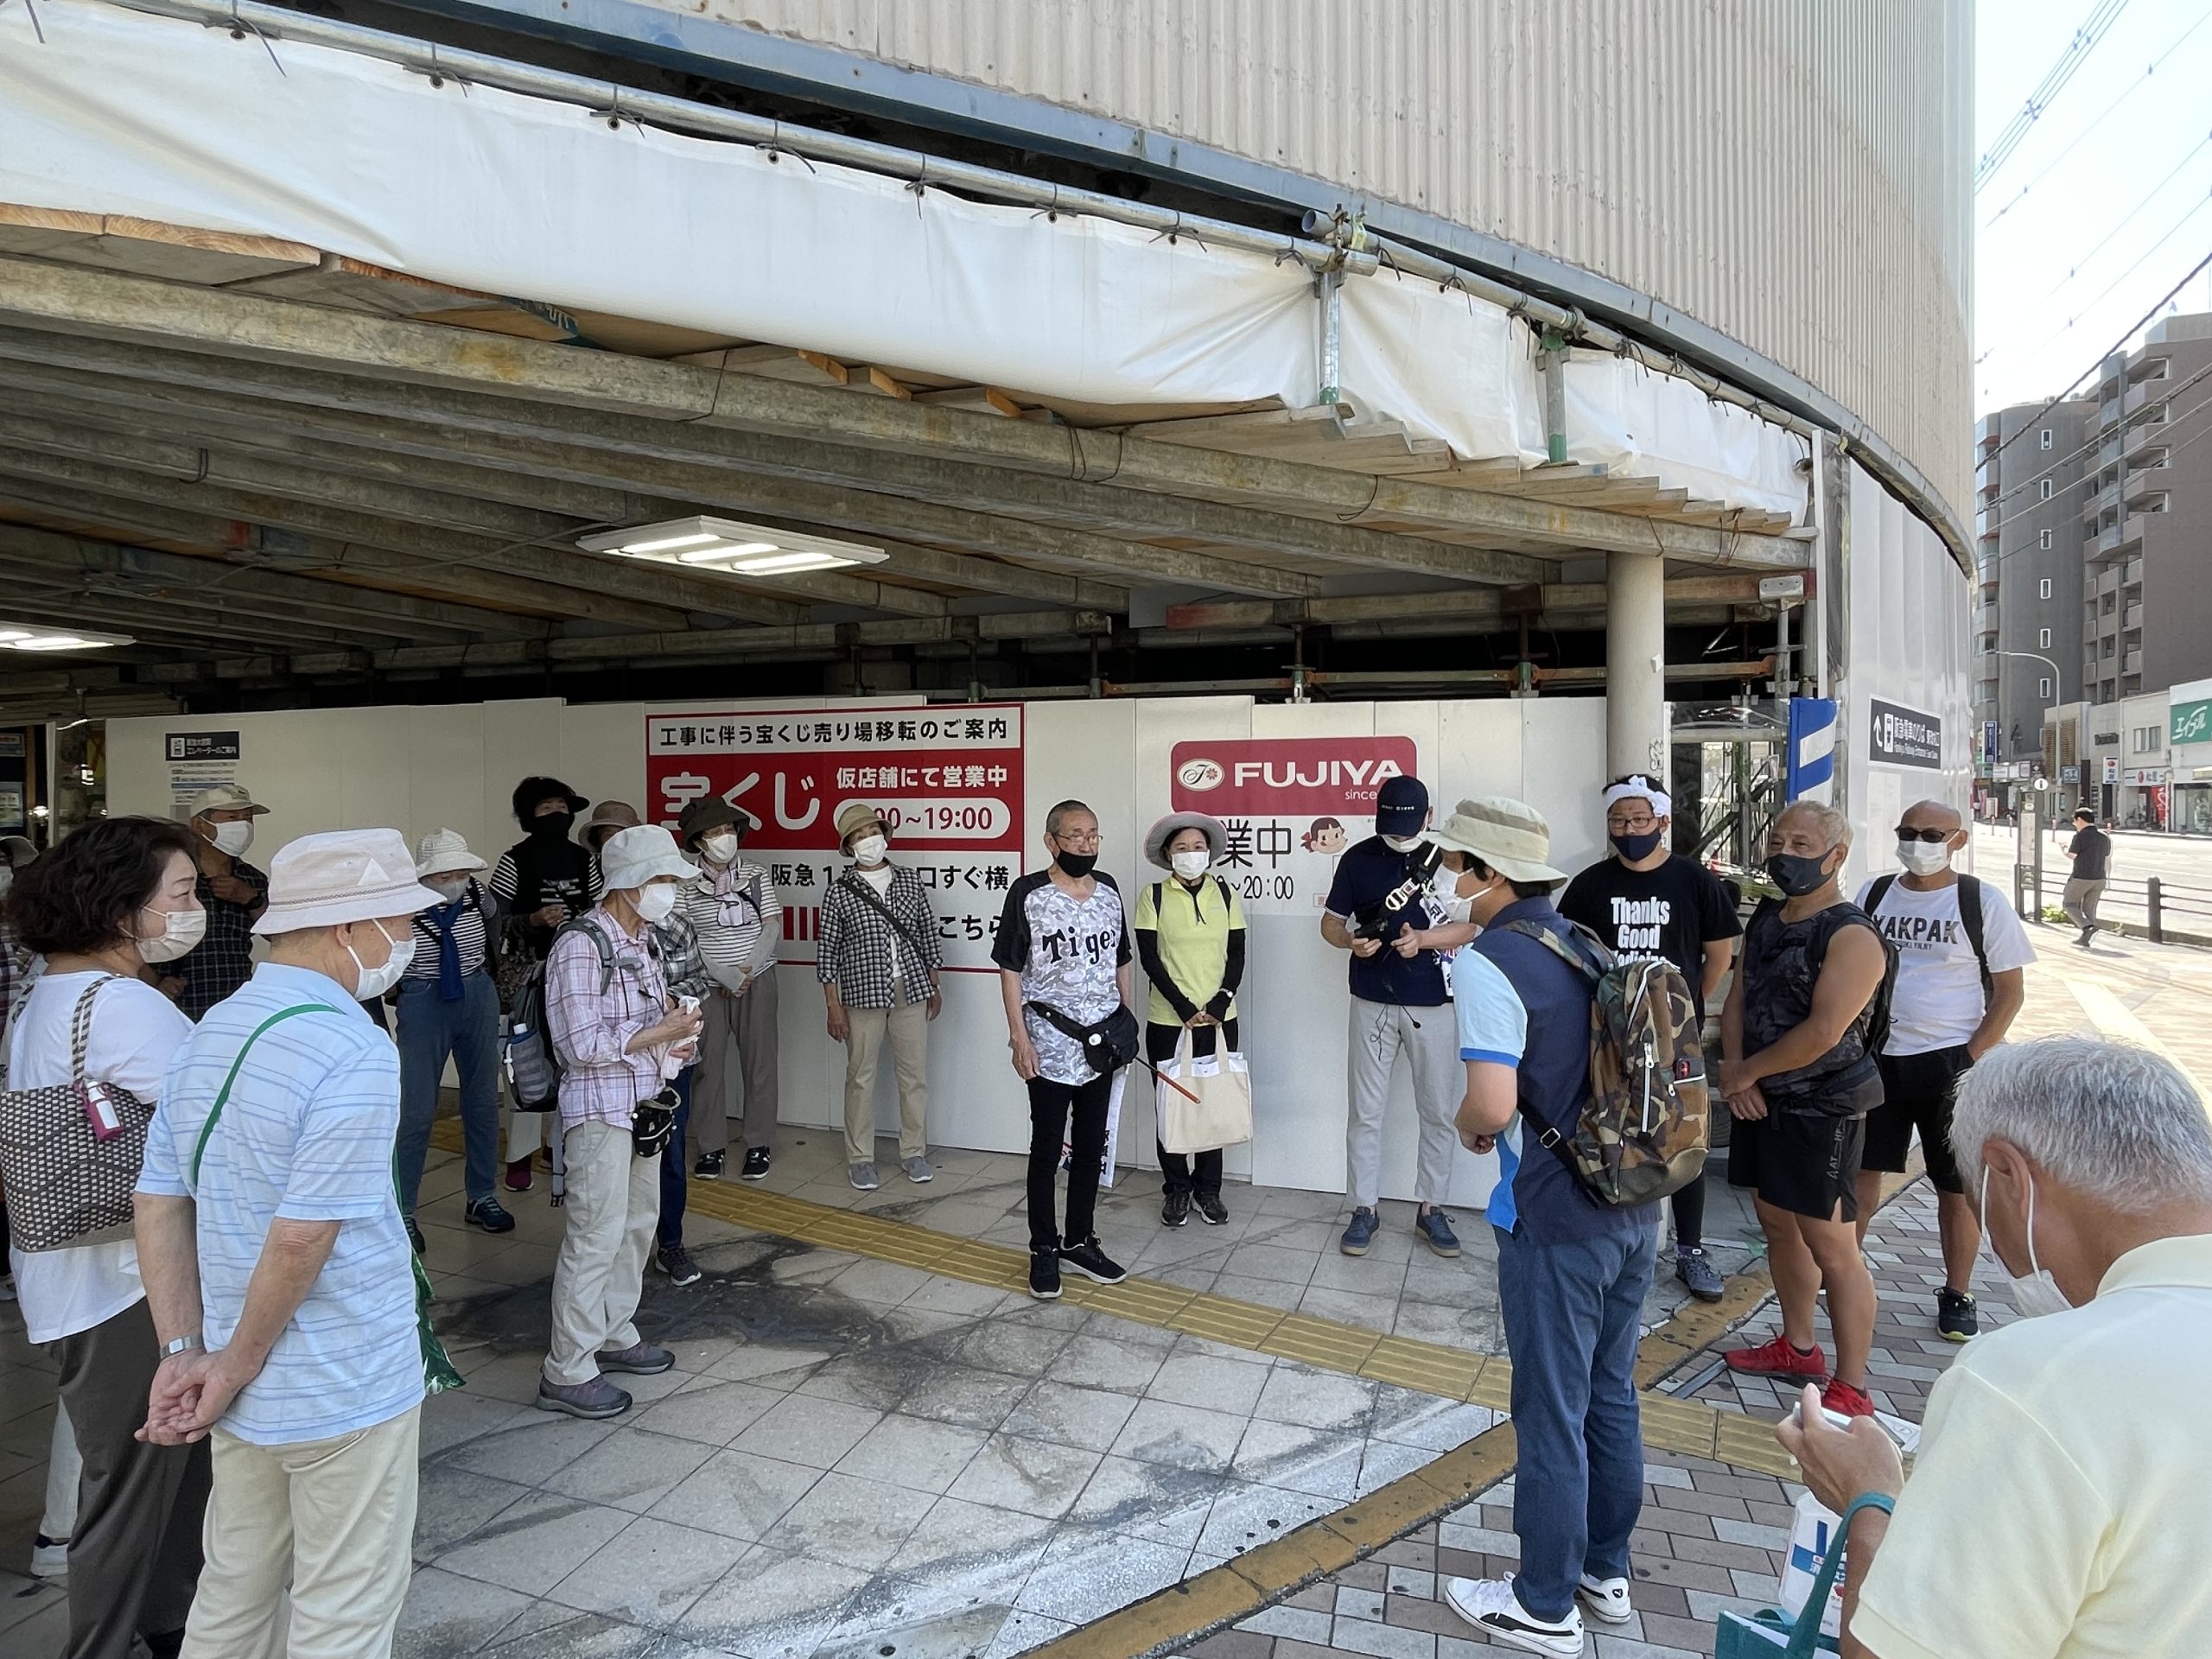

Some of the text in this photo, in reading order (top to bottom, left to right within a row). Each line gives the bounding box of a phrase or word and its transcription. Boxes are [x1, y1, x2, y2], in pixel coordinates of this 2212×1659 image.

[660, 717, 1007, 747] 工事に伴う宝くじ売り場移転のご案内
[2171, 705, 2208, 741] エイブル
[836, 765, 1007, 789] 仮店舗にて営業中
[1234, 760, 1403, 788] FUJIYA
[1344, 789, 1377, 800] since
[1611, 896, 1670, 925] Thanks
[1618, 924, 1661, 950] Good
